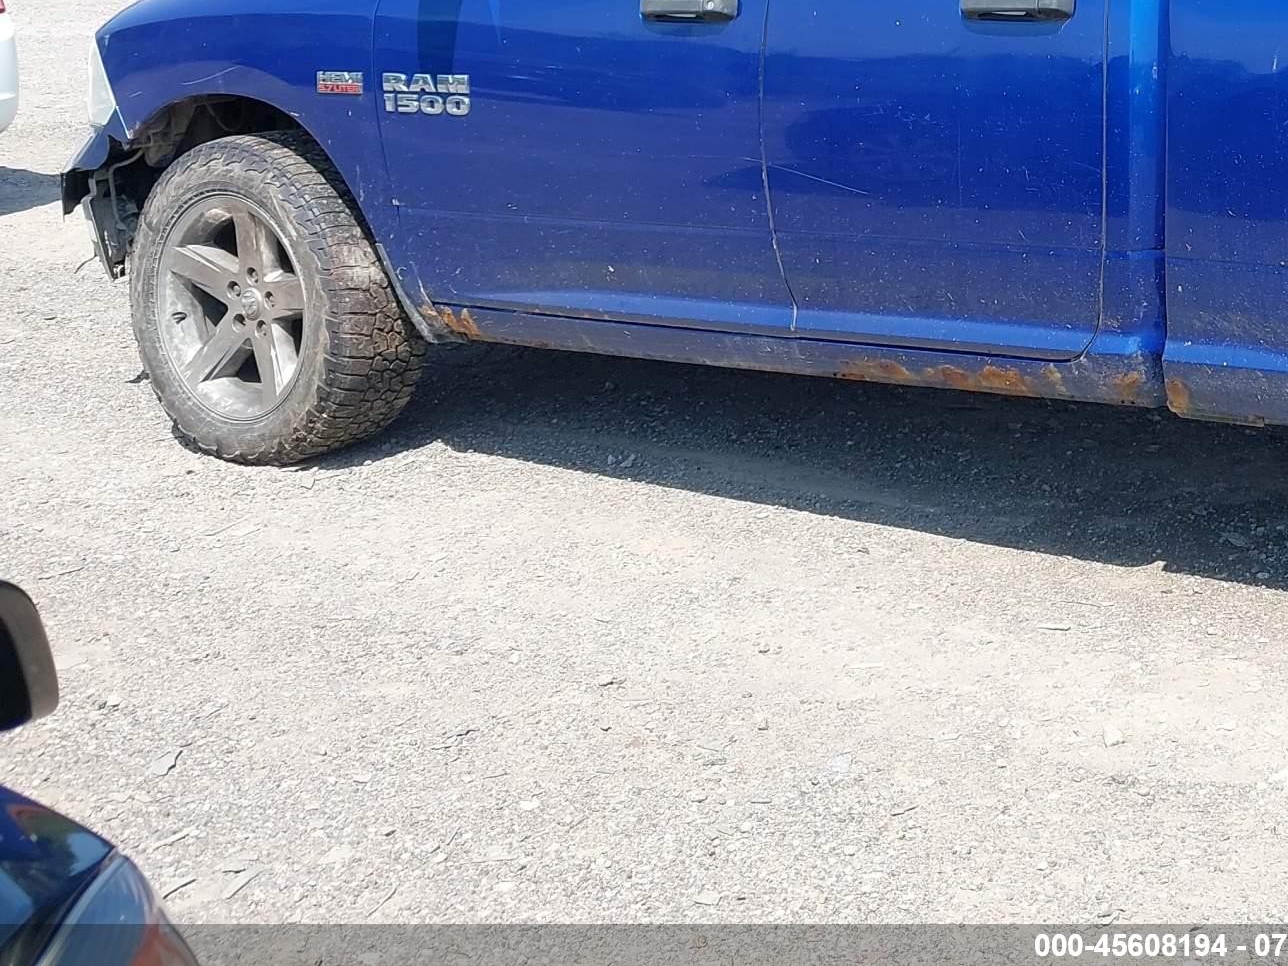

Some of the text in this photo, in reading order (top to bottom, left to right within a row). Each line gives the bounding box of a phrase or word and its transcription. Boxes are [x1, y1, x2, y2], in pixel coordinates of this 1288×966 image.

[317, 71, 363, 83] HEMI
[382, 73, 470, 93] RAM
[334, 85, 360, 93] LITER
[384, 93, 471, 116] 1500
